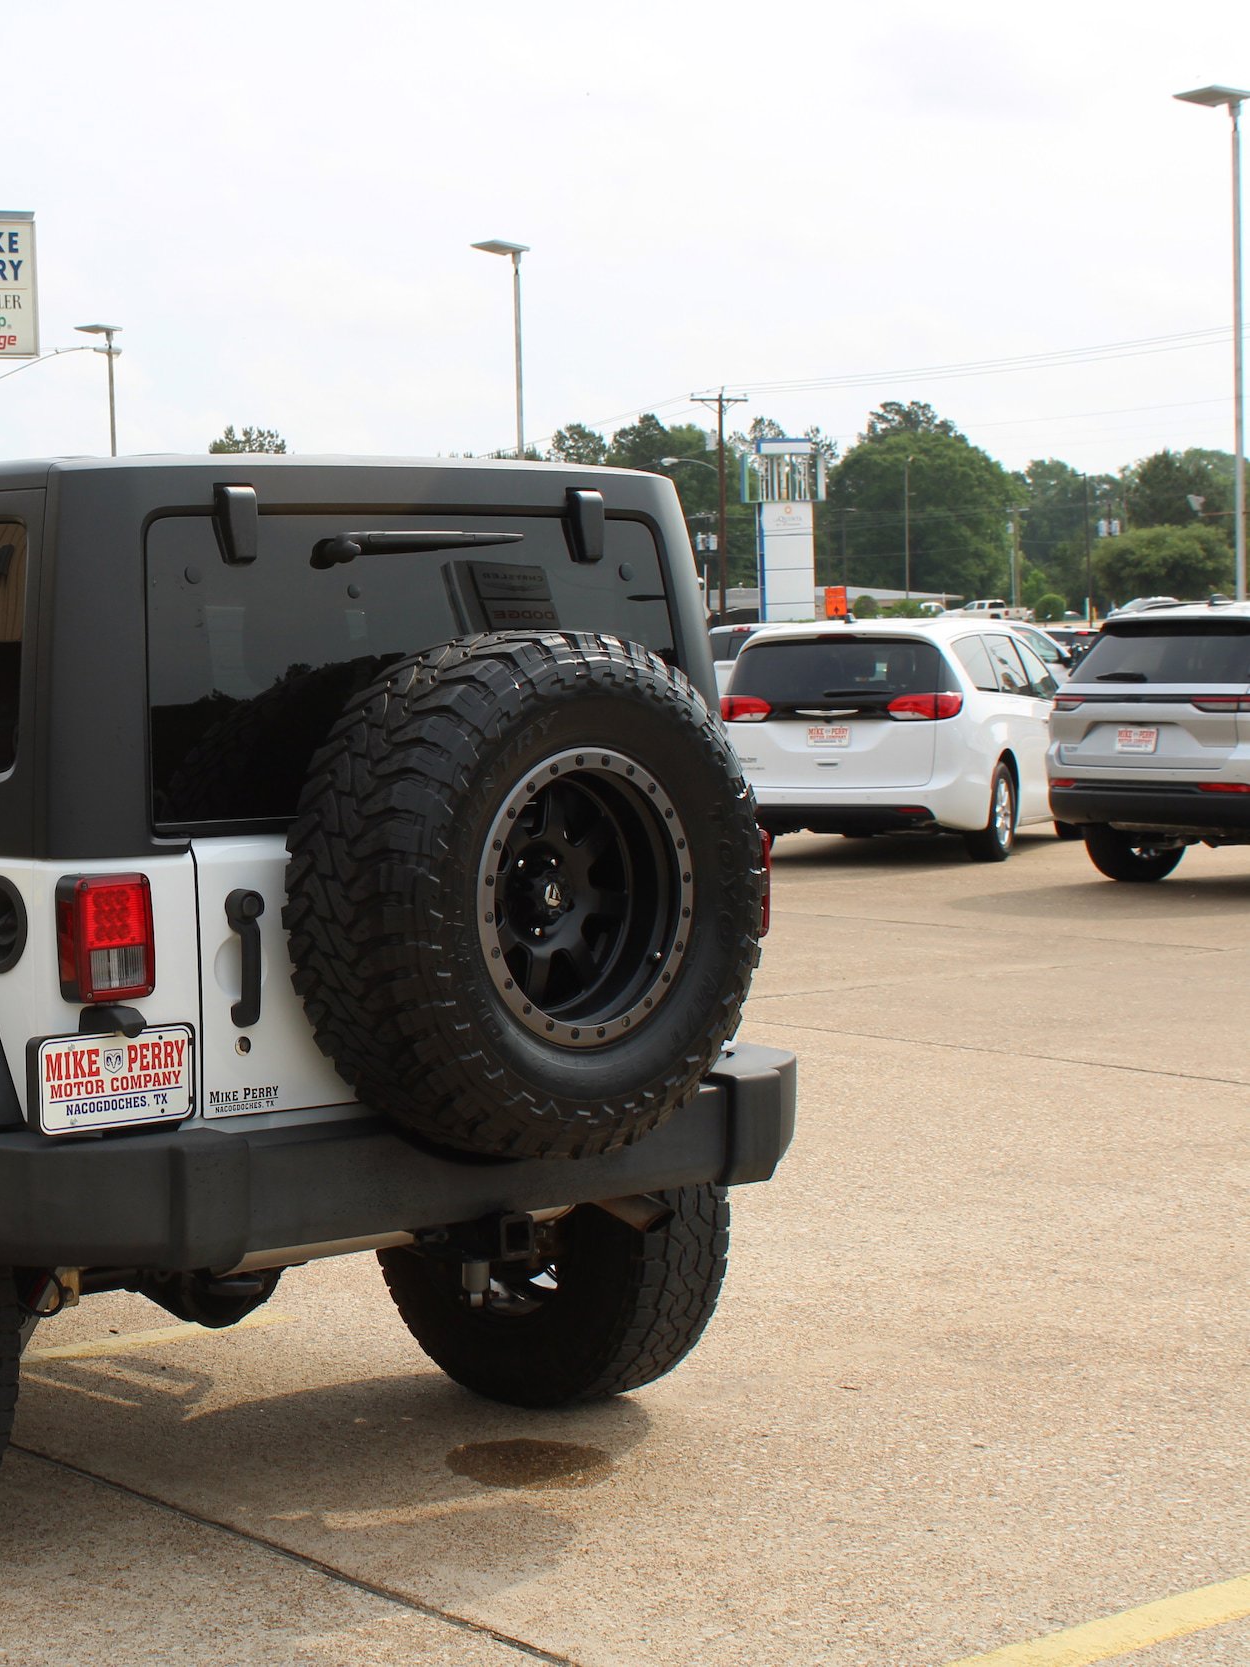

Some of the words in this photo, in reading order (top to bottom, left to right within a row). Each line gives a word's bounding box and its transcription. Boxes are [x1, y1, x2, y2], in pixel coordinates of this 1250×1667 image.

[45, 1048, 100, 1083] MIKE
[127, 1039, 186, 1073] PERRY
[50, 1077, 105, 1100] MOTOR
[110, 1070, 182, 1093] COMPANY
[153, 1093, 168, 1105] TX
